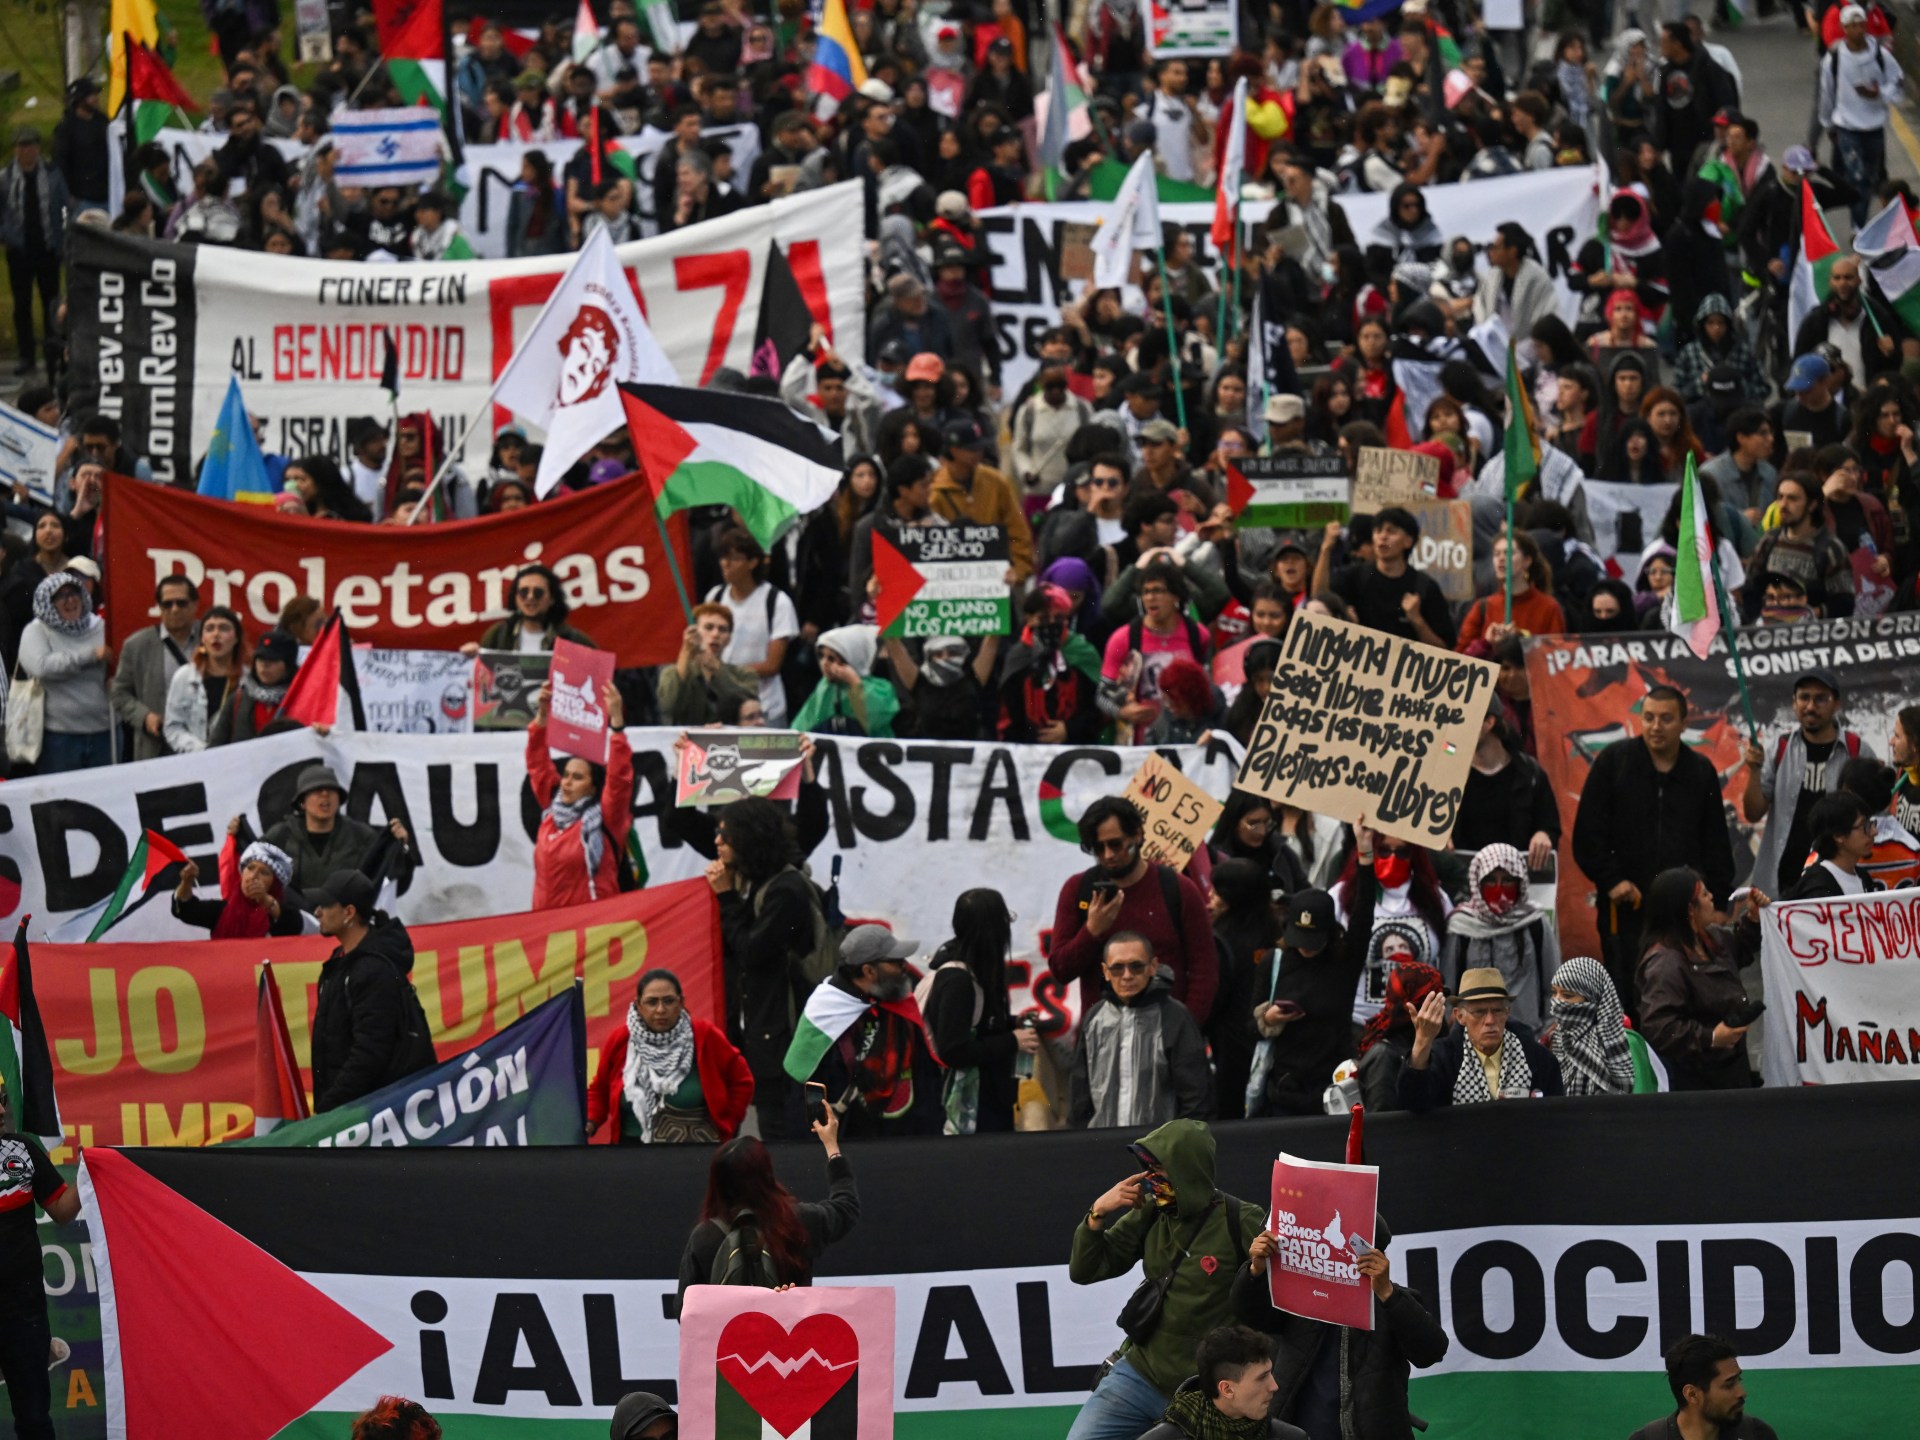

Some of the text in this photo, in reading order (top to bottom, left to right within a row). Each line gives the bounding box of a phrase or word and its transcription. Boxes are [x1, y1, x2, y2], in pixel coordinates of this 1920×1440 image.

[419, 274, 467, 305] FIN
[98, 270, 125, 419] rev.co
[232, 336, 262, 379] AL
[1408, 536, 1467, 570] LDITO
[147, 542, 650, 629] Proletaras
[904, 617, 941, 637] LOS
[905, 603, 929, 619] NO
[1856, 639, 1892, 663] DE
[803, 735, 1031, 848] ASTA
[1142, 774, 1204, 825] NO ES
[1778, 901, 1920, 966] GENO
[55, 919, 649, 1074] JO TUMP
[318, 1046, 529, 1147] PACIÓN
[121, 1101, 253, 1147] IMP
[1278, 1210, 1296, 1225] NO
[1278, 1223, 1321, 1241] SOMOS
[1278, 1235, 1330, 1260] PATIO
[1280, 1250, 1362, 1280] TRASERO
[410, 1232, 1920, 1406] ¡AL AL OCIDIO
